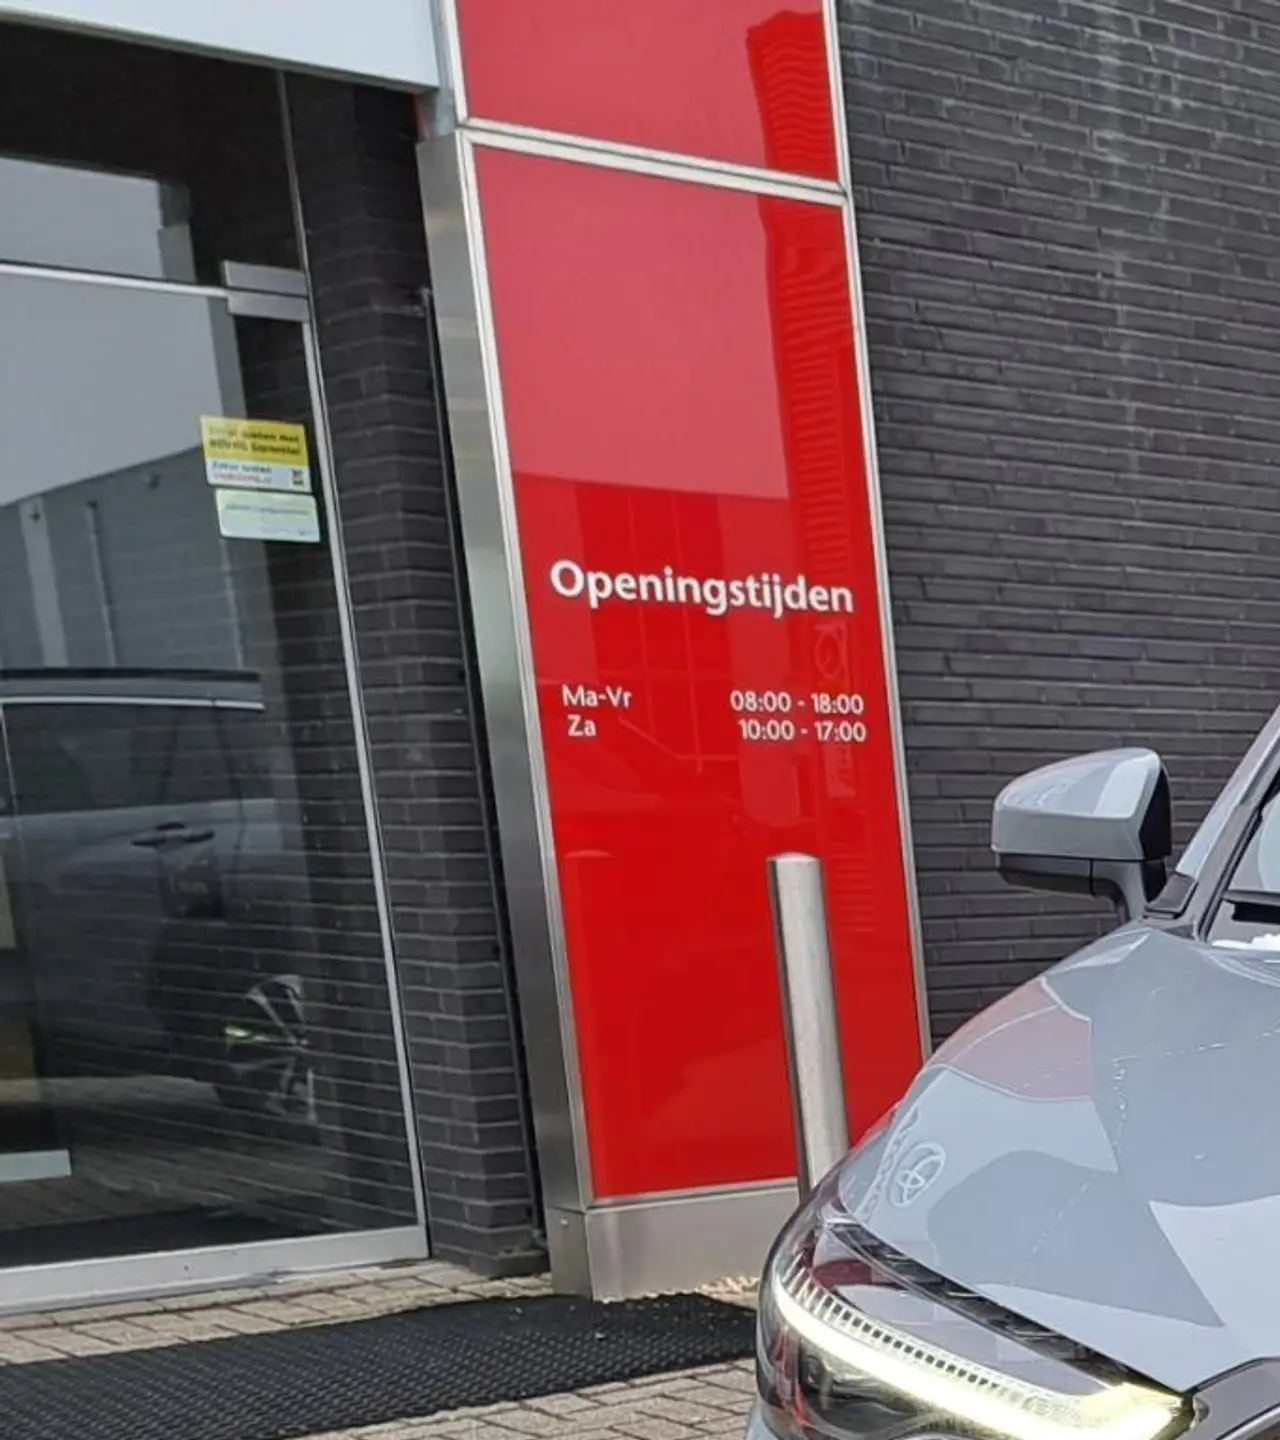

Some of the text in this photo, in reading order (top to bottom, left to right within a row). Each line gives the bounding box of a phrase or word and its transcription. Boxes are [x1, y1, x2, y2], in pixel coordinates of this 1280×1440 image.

[550, 559, 855, 619] Openingstijden
[562, 684, 632, 709] Ma-Vr
[730, 690, 791, 713] 08:00
[811, 693, 864, 715] 18:00
[567, 714, 597, 737] Za
[738, 719, 795, 741] 10:00
[815, 721, 867, 743] 17:00
